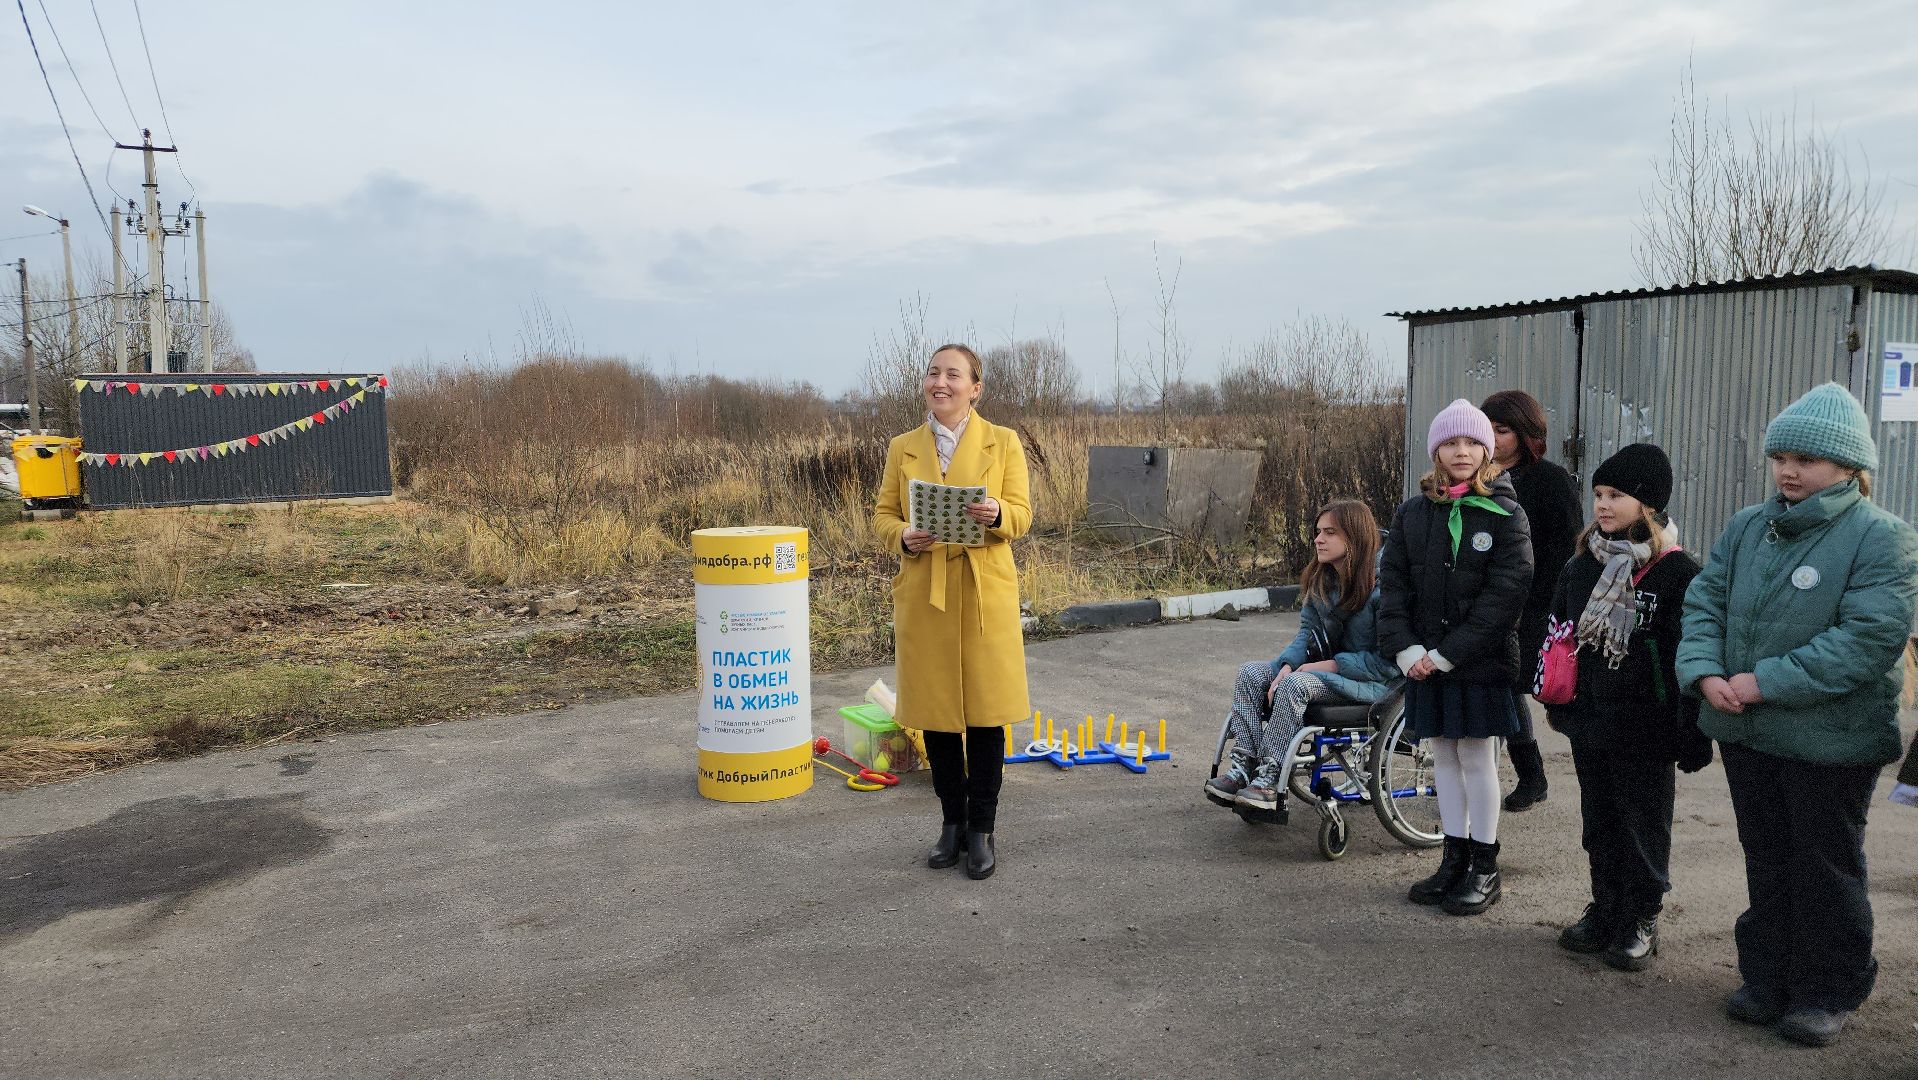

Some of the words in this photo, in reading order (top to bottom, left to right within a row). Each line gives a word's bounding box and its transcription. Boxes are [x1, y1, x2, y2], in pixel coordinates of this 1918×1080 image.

[712, 648, 791, 667] ПЛАСТИК
[713, 672, 723, 688] В
[729, 670, 788, 689] ОБМЕН
[713, 694, 735, 710] НА
[741, 690, 799, 710] ЖИЗНЬ
